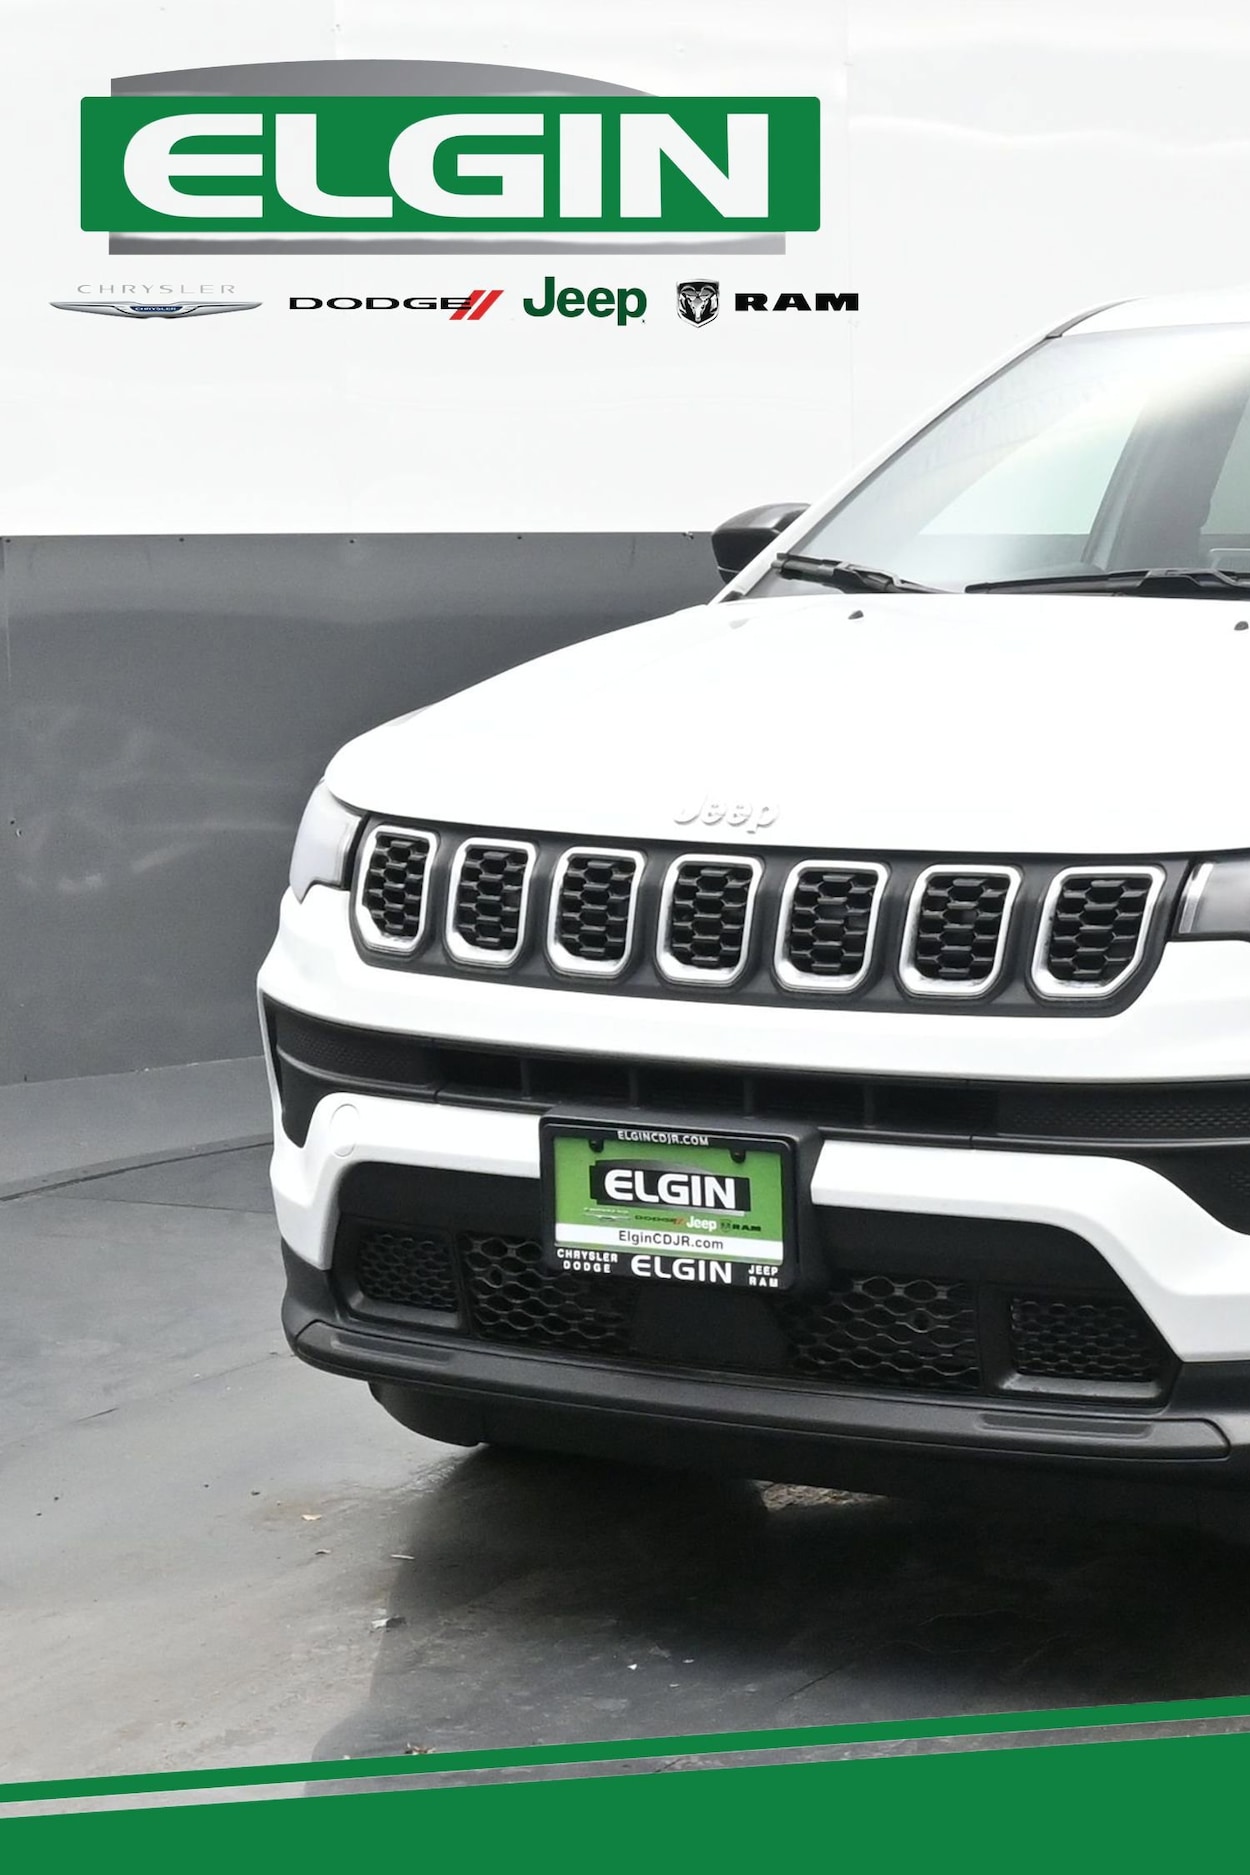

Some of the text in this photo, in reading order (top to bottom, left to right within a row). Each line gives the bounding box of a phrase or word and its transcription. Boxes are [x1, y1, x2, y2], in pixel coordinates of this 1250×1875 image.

[673, 790, 781, 834] Jeep
[617, 1130, 709, 1146] ELGINCDJR.COM
[604, 1169, 736, 1209] ELGIN
[686, 1216, 717, 1232] Jeep
[732, 1224, 761, 1232] RAM
[618, 1230, 724, 1250] ElginCDJR.com
[556, 1248, 618, 1263] CHRYSLER
[563, 1260, 611, 1274] DODGE
[631, 1255, 732, 1284] ELGIN
[748, 1265, 778, 1277] JEEP
[749, 1276, 778, 1287] RAM
